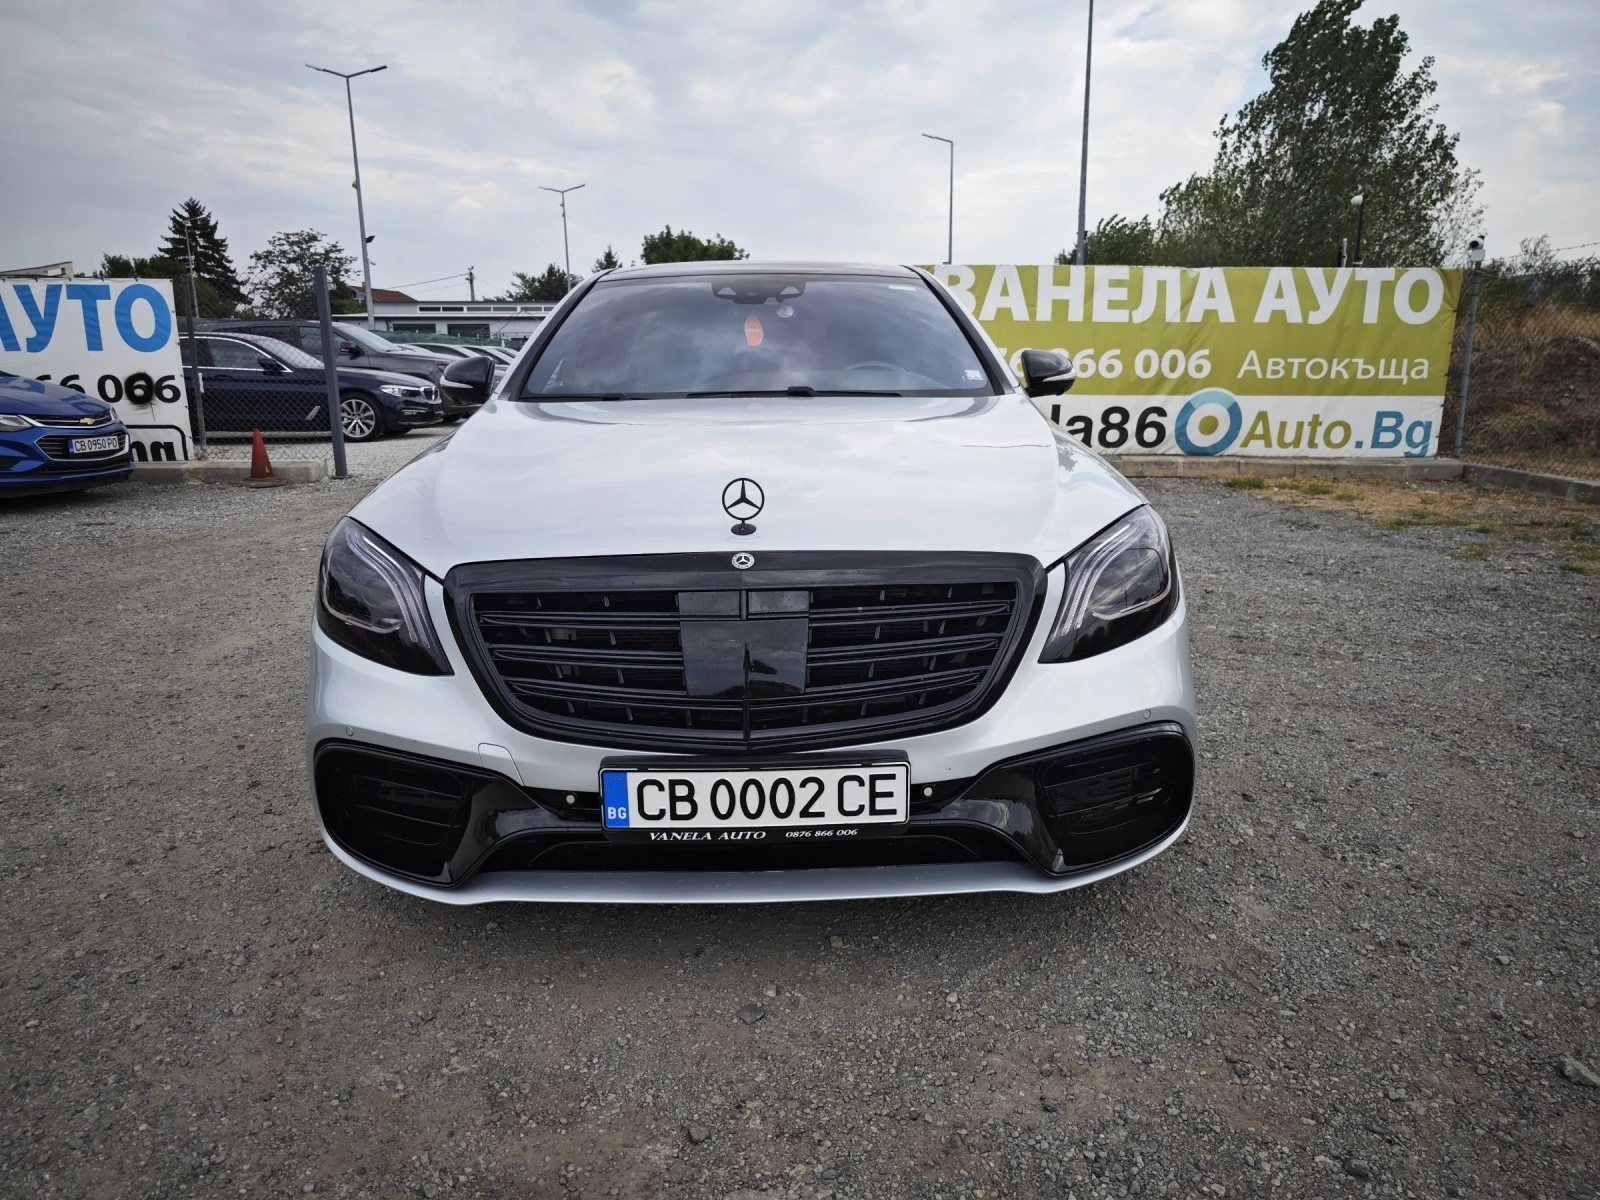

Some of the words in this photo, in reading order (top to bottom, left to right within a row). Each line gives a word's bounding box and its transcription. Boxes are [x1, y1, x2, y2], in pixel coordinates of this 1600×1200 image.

[1253, 267, 1445, 325] АУТО
[1134, 348, 1212, 380] 006
[1236, 350, 1430, 385] Автокъща
[74, 440, 86, 452] CB
[87, 438, 107, 451] 0950
[637, 779, 698, 821] CB
[710, 777, 825, 820] 0002
[837, 773, 897, 817] CE
[607, 806, 627, 820] BG
[649, 831, 712, 841] VANELA
[718, 830, 767, 841] AUTO
[785, 830, 812, 838] 0876
[814, 829, 835, 837] 866
[836, 828, 859, 836] 006
